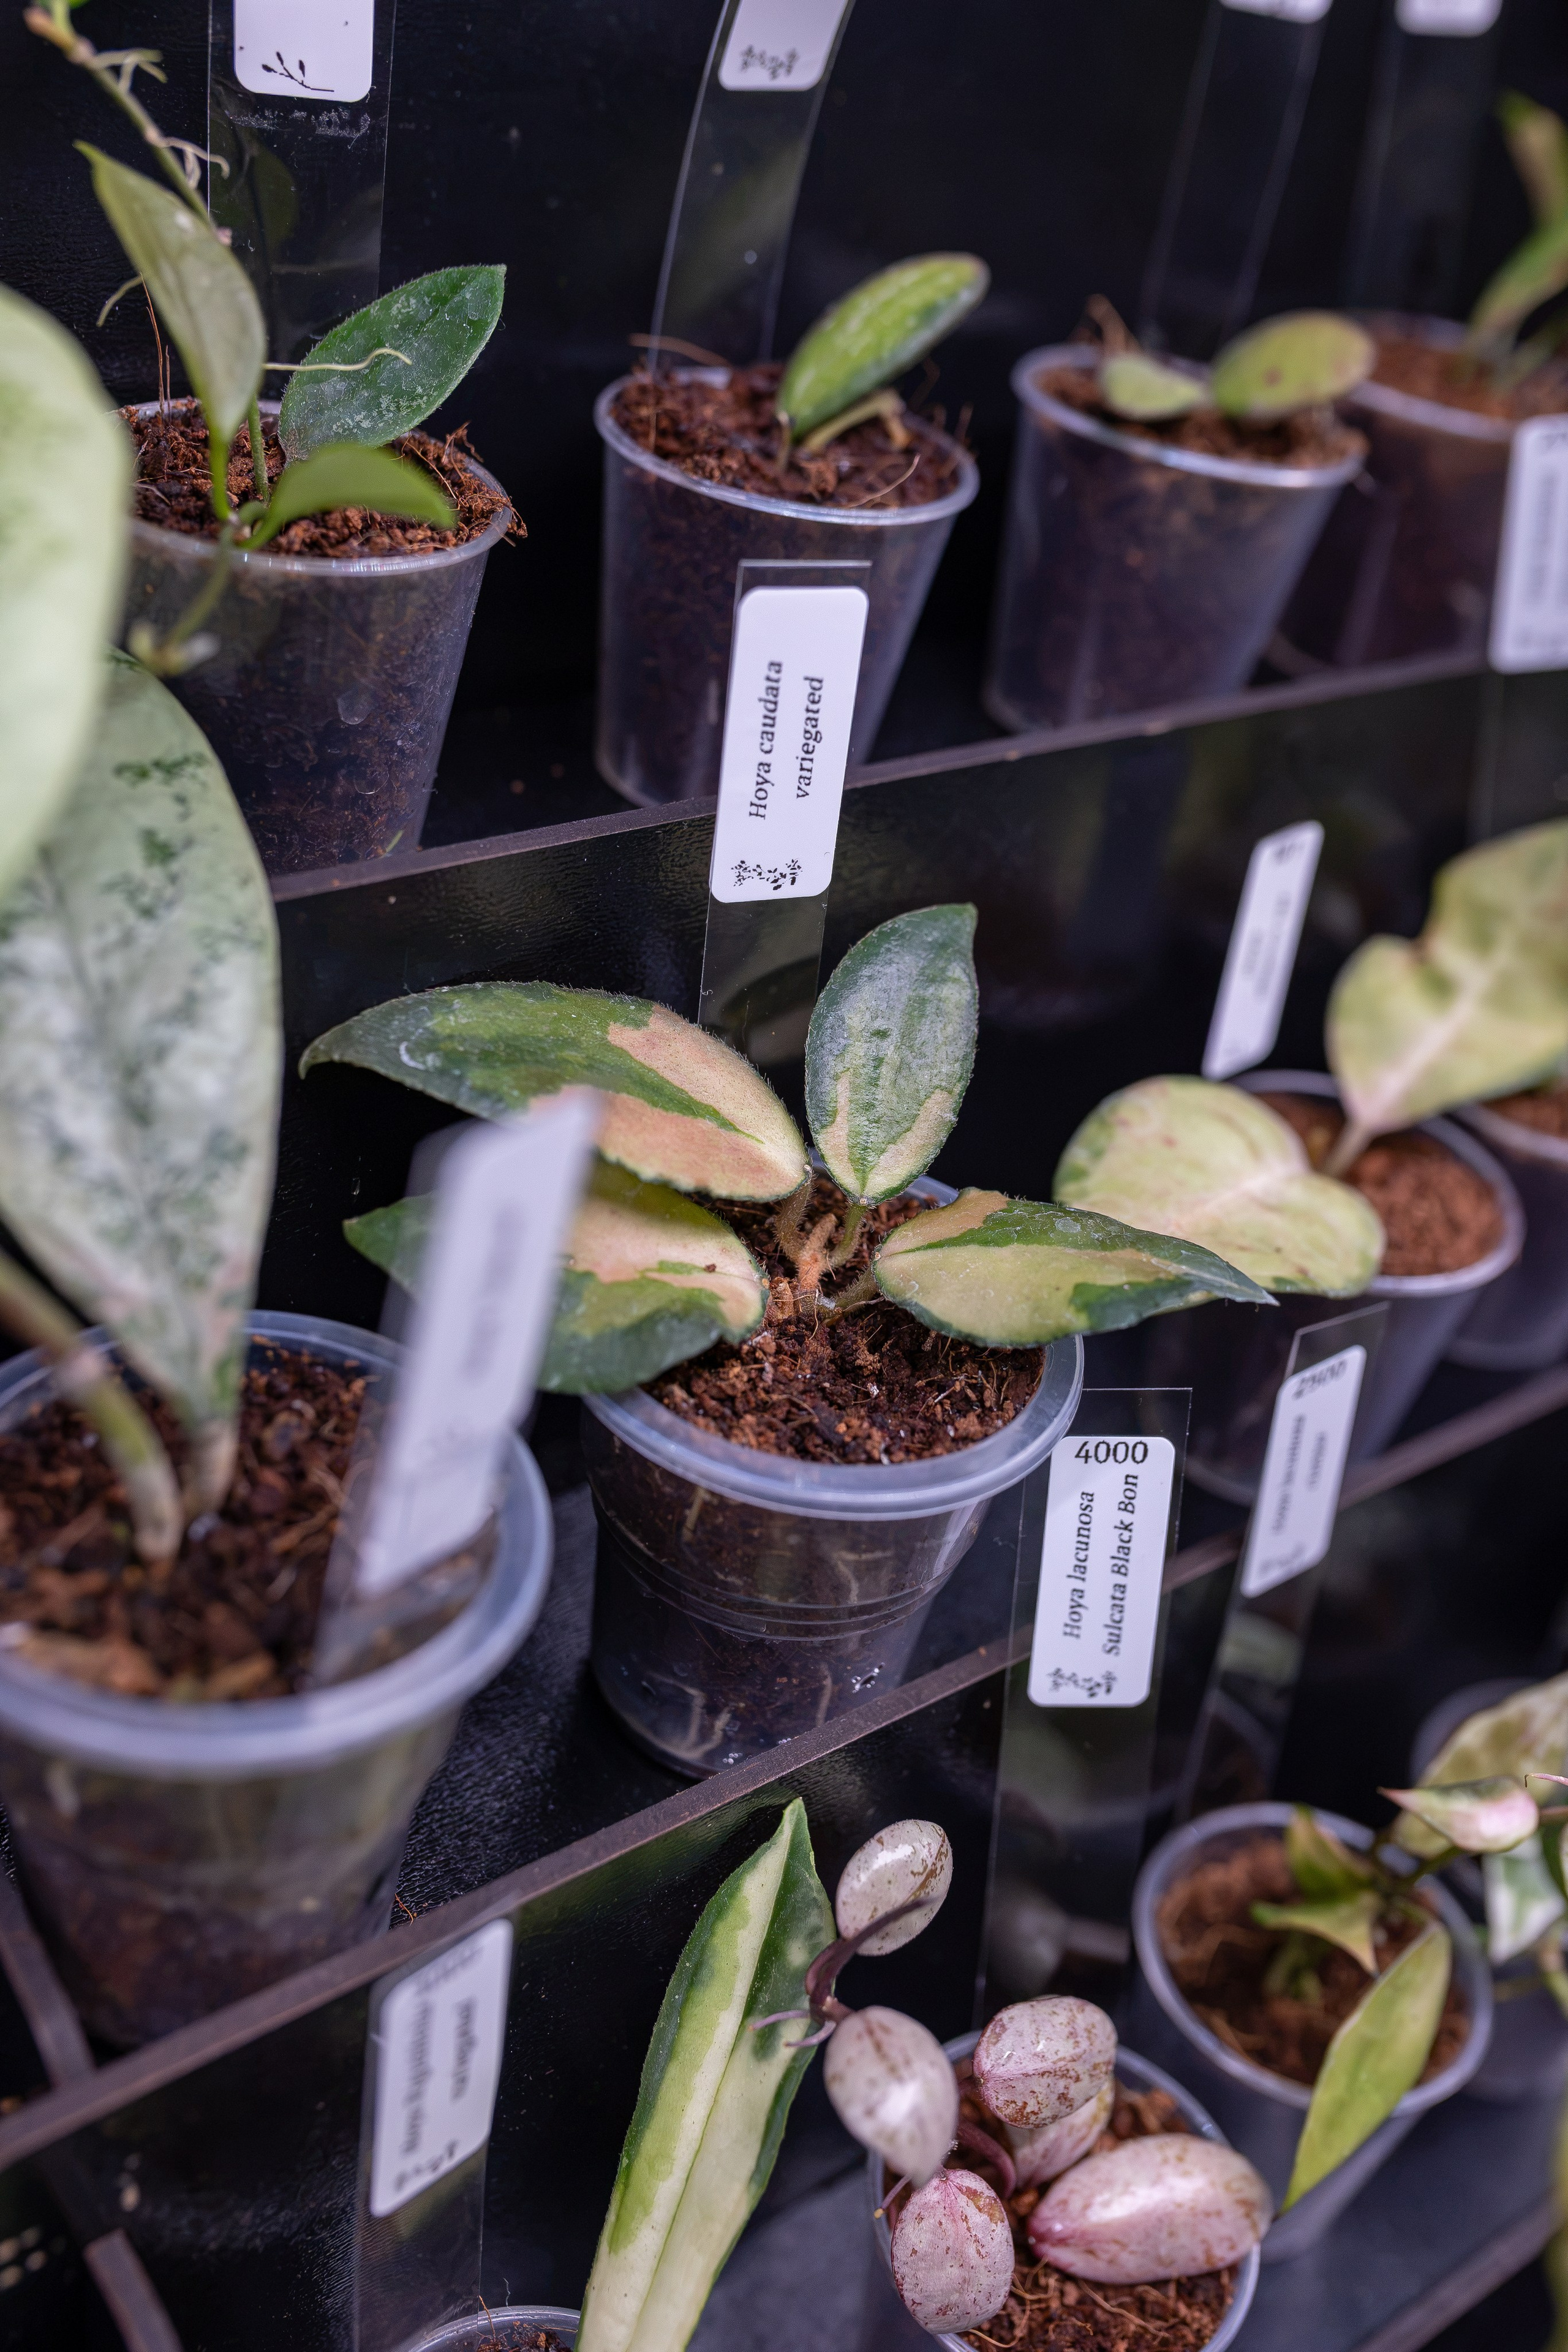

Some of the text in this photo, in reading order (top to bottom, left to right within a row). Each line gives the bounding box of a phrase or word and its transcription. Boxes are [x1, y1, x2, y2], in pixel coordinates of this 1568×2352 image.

[748, 660, 783, 821] Hoya caudata
[795, 675, 824, 800] variegated
[1074, 1439, 1149, 1466] 4000
[1062, 1490, 1095, 1640] Hoya lacunosa
[1102, 1472, 1139, 1657] Sulcata Black Bon
